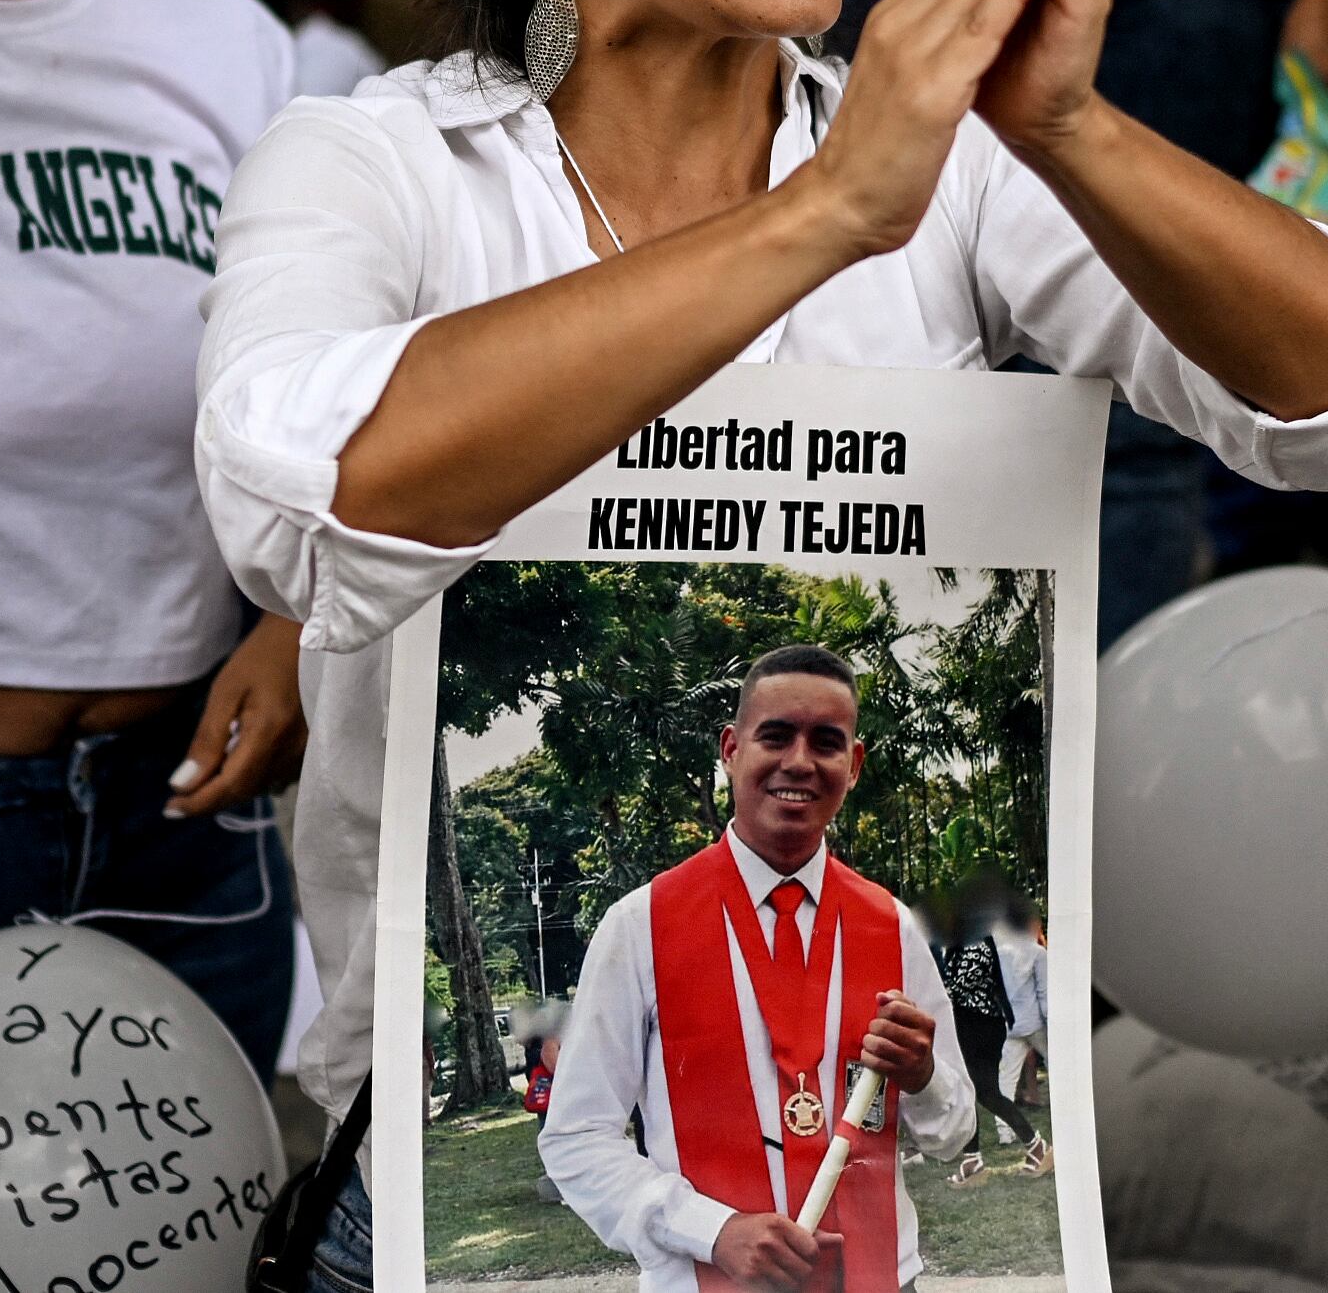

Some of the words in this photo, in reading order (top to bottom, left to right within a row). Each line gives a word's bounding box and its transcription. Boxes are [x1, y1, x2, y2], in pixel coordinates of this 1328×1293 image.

[616, 417, 793, 472] Libertad
[807, 428, 907, 481] para
[587, 497, 767, 553] KENNEDY
[780, 501, 927, 557] TEJEDA
